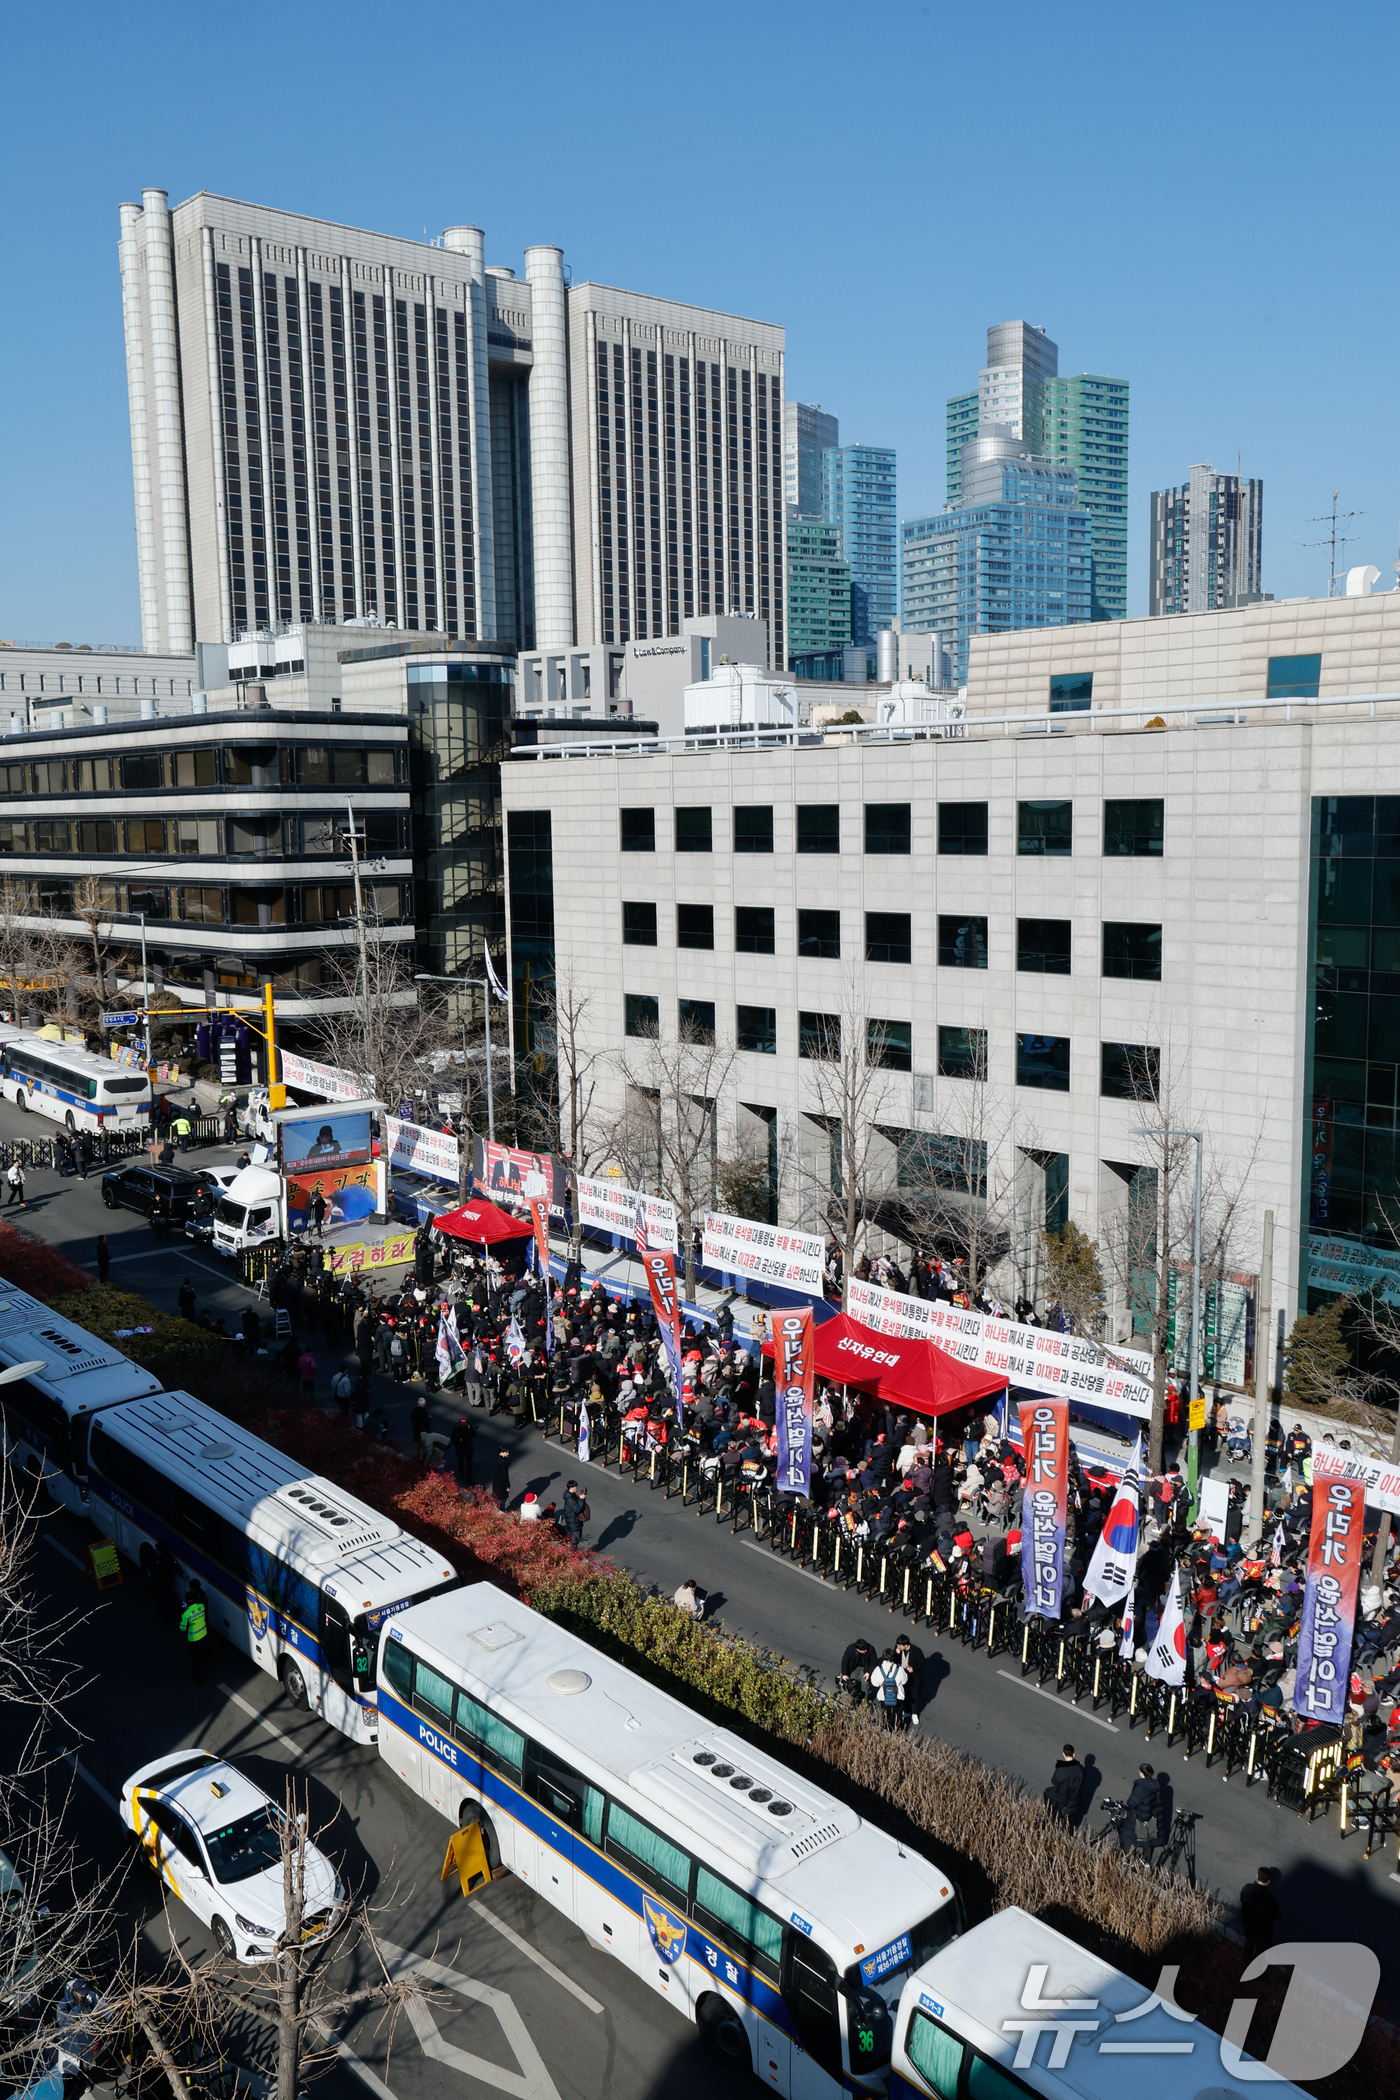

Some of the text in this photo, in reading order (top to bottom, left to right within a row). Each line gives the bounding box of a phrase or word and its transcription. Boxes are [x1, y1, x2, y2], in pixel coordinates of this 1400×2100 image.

[639, 646, 687, 656] Law&Company
[75, 1099, 87, 1109] POLICE
[579, 1182, 602, 1200] 하나님께서
[580, 1201, 604, 1219] 하나님께서
[605, 1209, 634, 1230] 윤석열대통령
[707, 1218, 822, 1258] 하나님께서 윤석열대통령님 부활 복귀시킨다
[704, 1241, 820, 1284] 하나님께서 곧 이재명과 공산당을 심판하신다
[850, 1285, 980, 1336] 하나님께서 윤석열대통령님 부활 복귀시킨다
[837, 1336, 901, 1368] 신자유연대
[985, 1323, 1024, 1347] 하나님께서
[1026, 1334, 1035, 1349] 곧
[1036, 1336, 1069, 1357] 이재명과
[1071, 1345, 1105, 1367] 공산당을
[985, 1350, 1024, 1374] 하나님께서
[1026, 1361, 1034, 1376] 곧
[1036, 1363, 1069, 1384] 이재명과
[1070, 1371, 1105, 1393] 공산당을
[1106, 1380, 1150, 1404] 심판하신다
[1366, 1469, 1381, 1489] 곧
[110, 1490, 134, 1518] POLICE
[381, 1601, 410, 1616] 서울기동경찰
[356, 1657, 368, 1673] 32
[419, 1724, 457, 1766] POLICE
[655, 1941, 674, 1961] POLICE
[876, 1937, 908, 1964] 서울기동경찰
[877, 1948, 910, 1974] 제36기동대-1
[858, 2030, 874, 2053] 36
